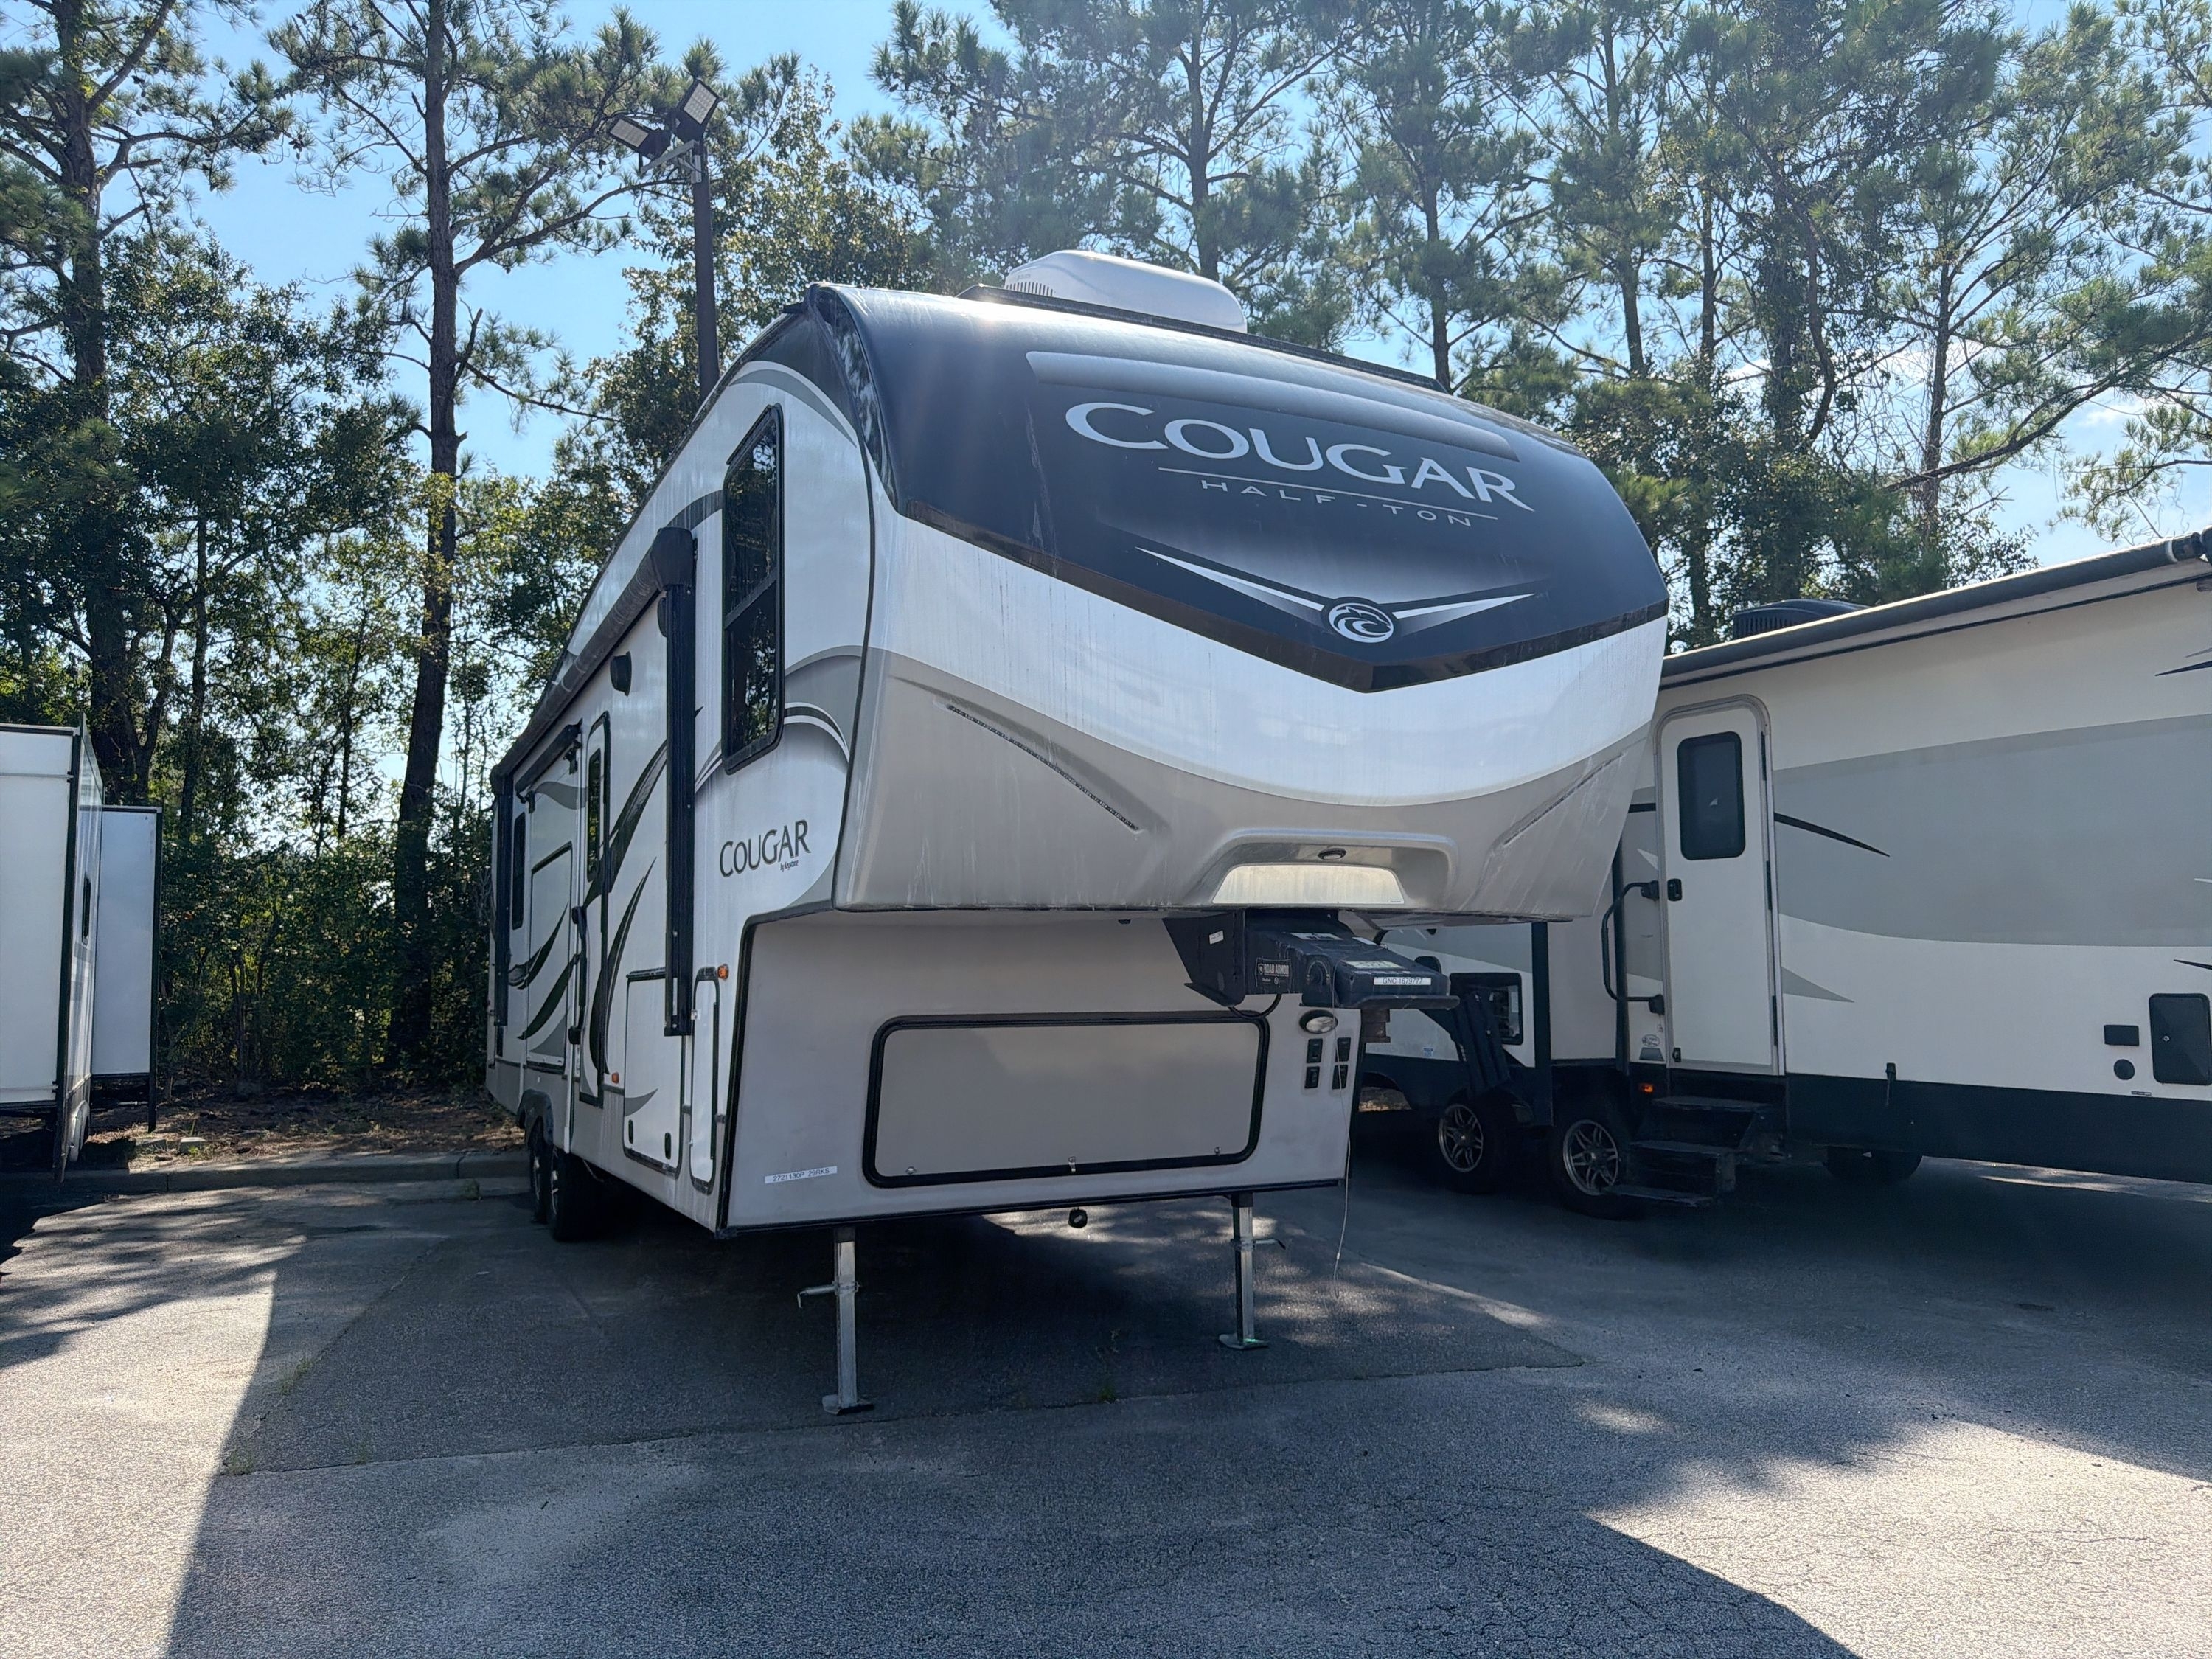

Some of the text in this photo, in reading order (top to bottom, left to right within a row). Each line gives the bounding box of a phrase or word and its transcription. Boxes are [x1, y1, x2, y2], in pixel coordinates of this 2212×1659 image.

[1065, 401, 1535, 512] COUGAR
[1201, 479, 1472, 528] HALF-TON
[719, 818, 812, 878] COUGAR
